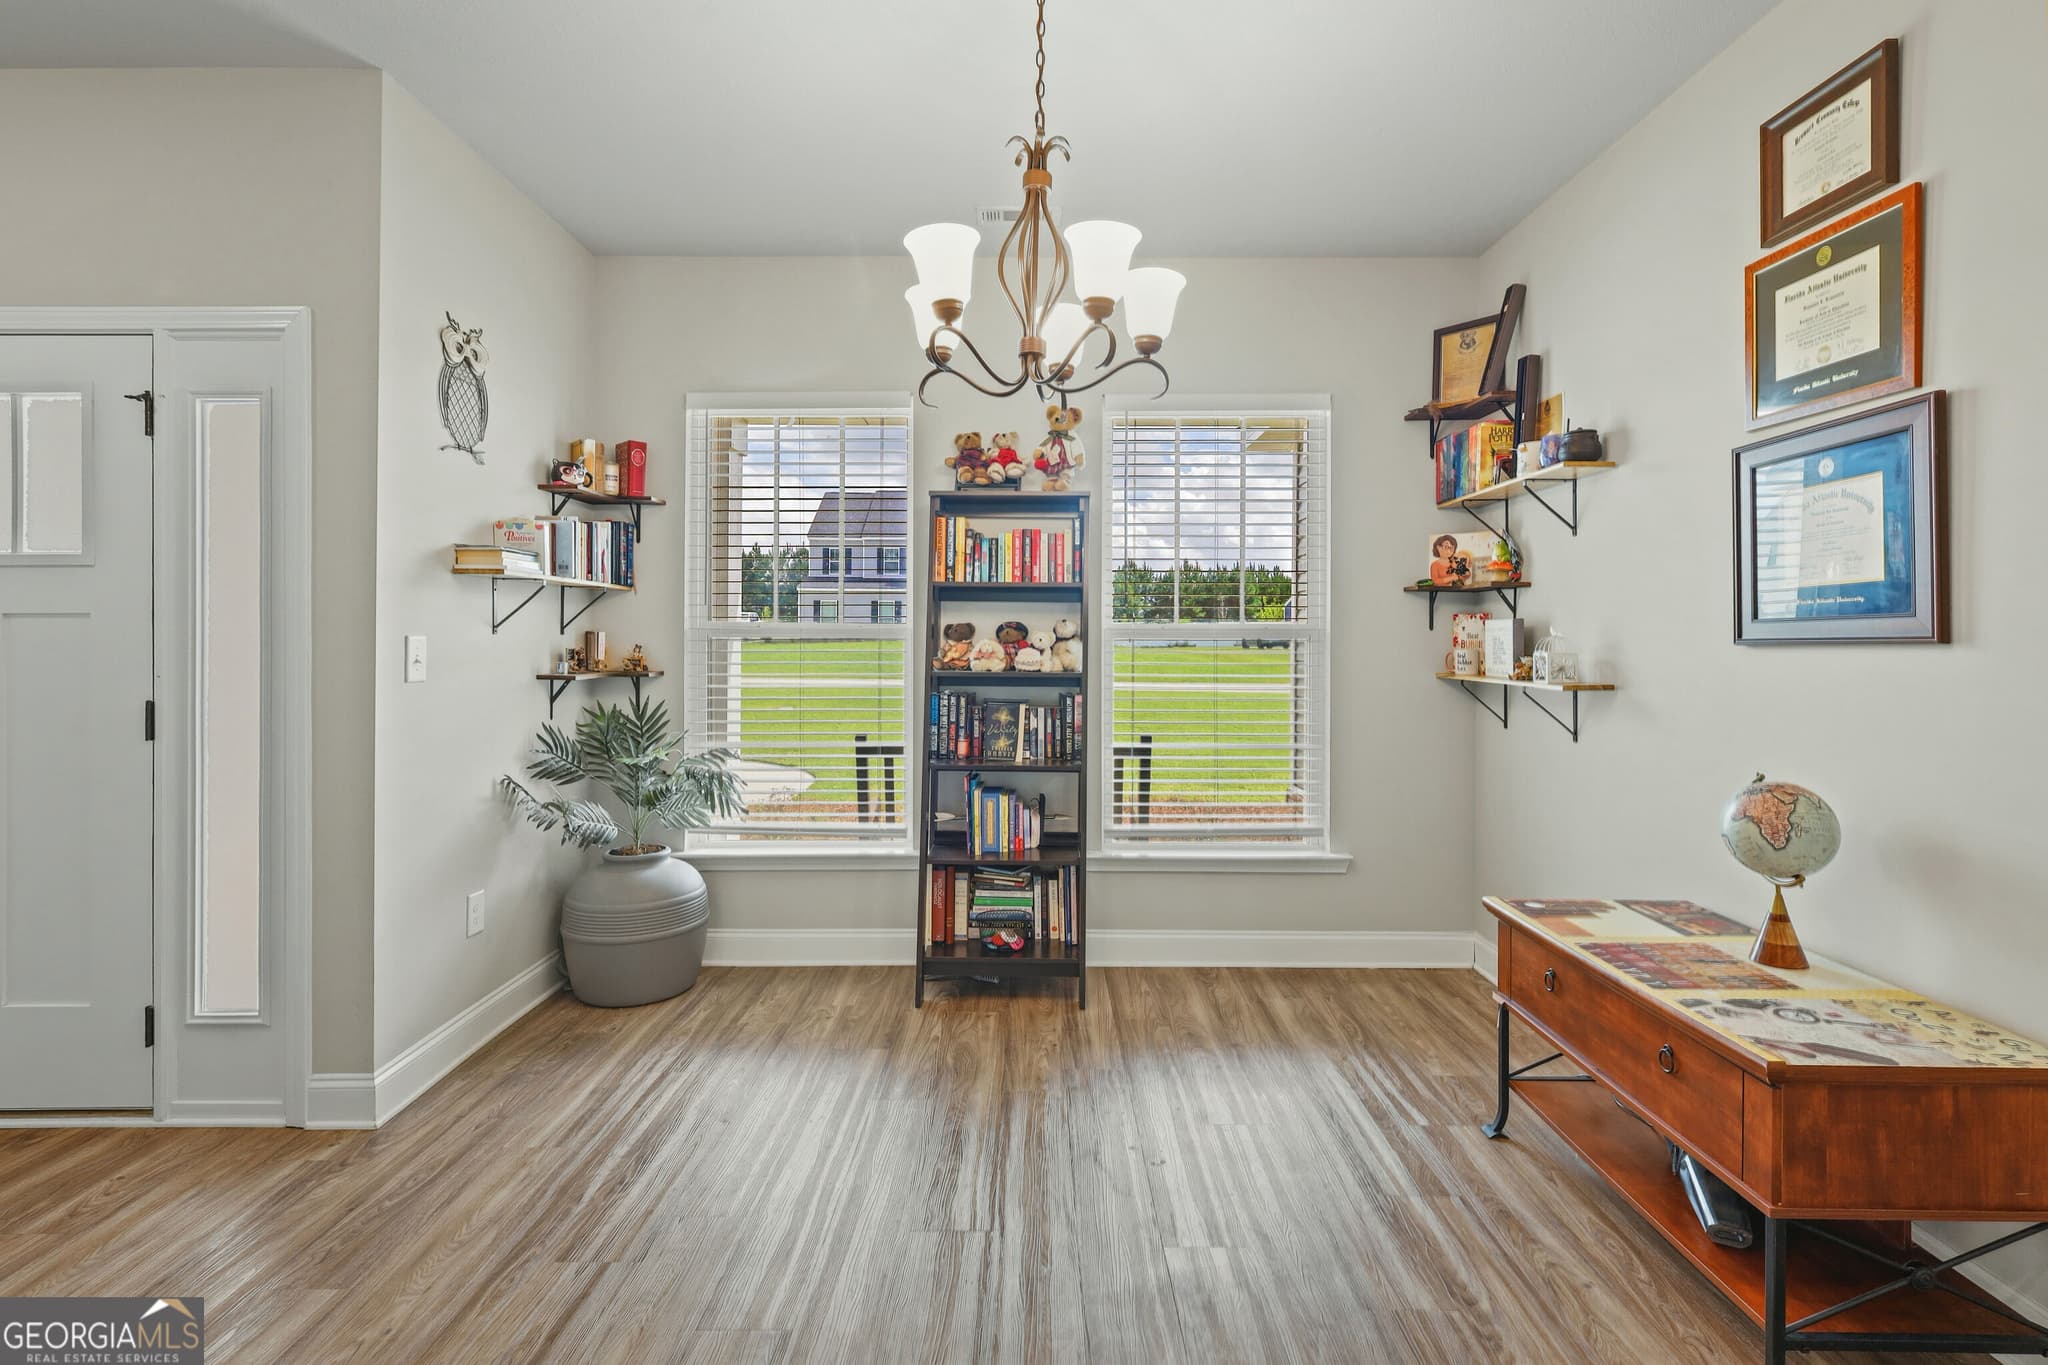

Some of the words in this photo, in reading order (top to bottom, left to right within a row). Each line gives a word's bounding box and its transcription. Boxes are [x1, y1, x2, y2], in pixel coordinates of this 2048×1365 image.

[1784, 290, 1806, 304] Florida
[1807, 279, 1831, 295] Atlantic
[1833, 263, 1867, 284] University
[1793, 384, 1810, 394] Florida
[1812, 377, 1830, 388] Atlantic
[1832, 369, 1859, 382] University
[1489, 433, 1514, 444] POTTE
[1490, 425, 1514, 435] HARR
